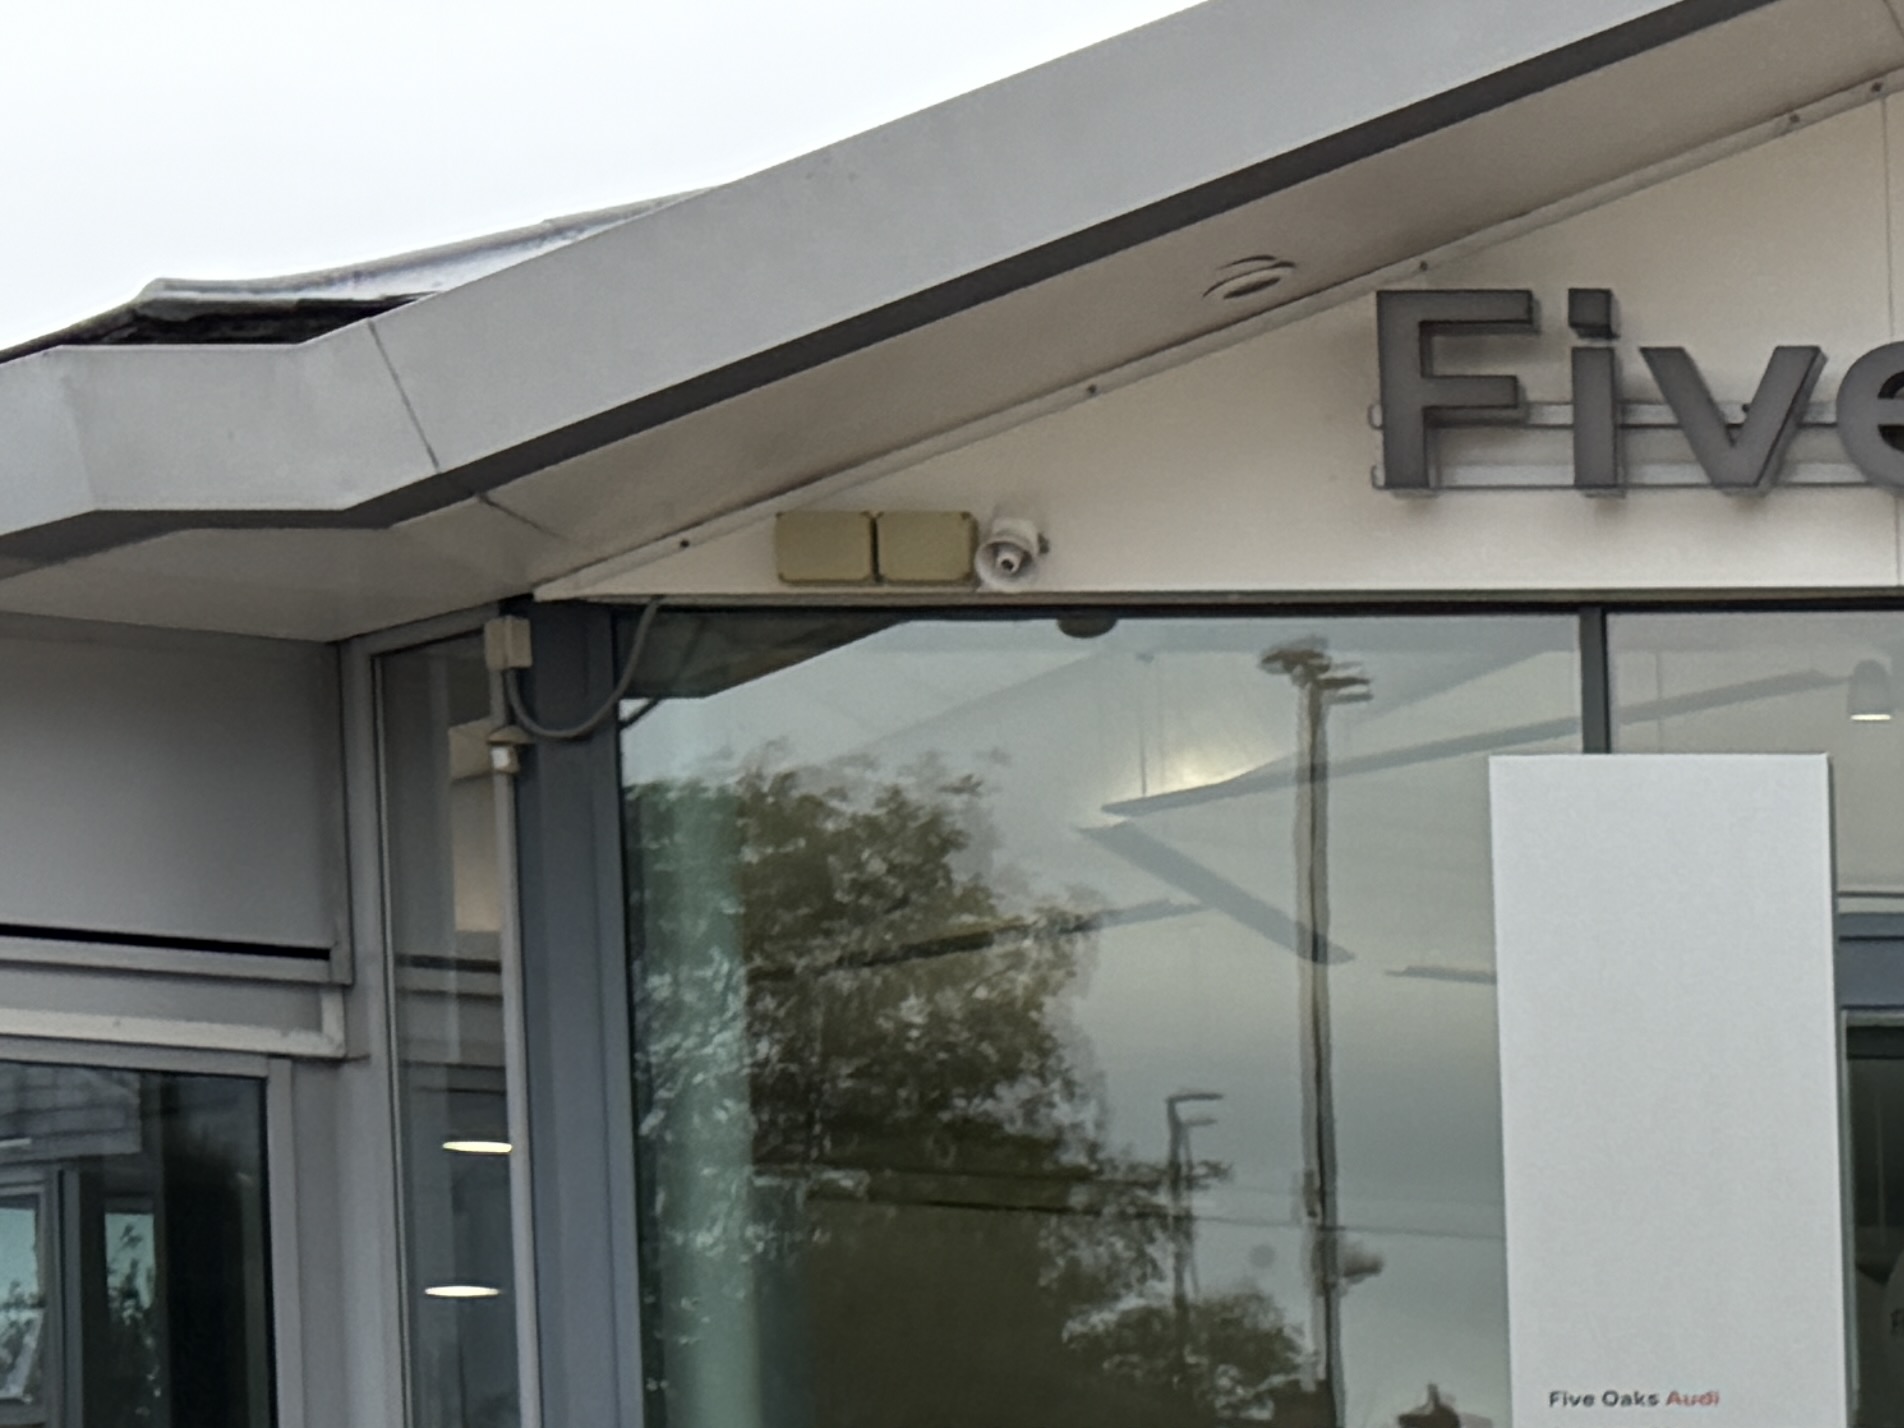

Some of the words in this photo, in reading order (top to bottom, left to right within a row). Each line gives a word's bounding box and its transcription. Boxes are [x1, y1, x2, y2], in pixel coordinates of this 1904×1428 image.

[1549, 1389, 1596, 1407] Five
[1601, 1389, 1661, 1407] Oaks
[1665, 1389, 1720, 1406] Audi
